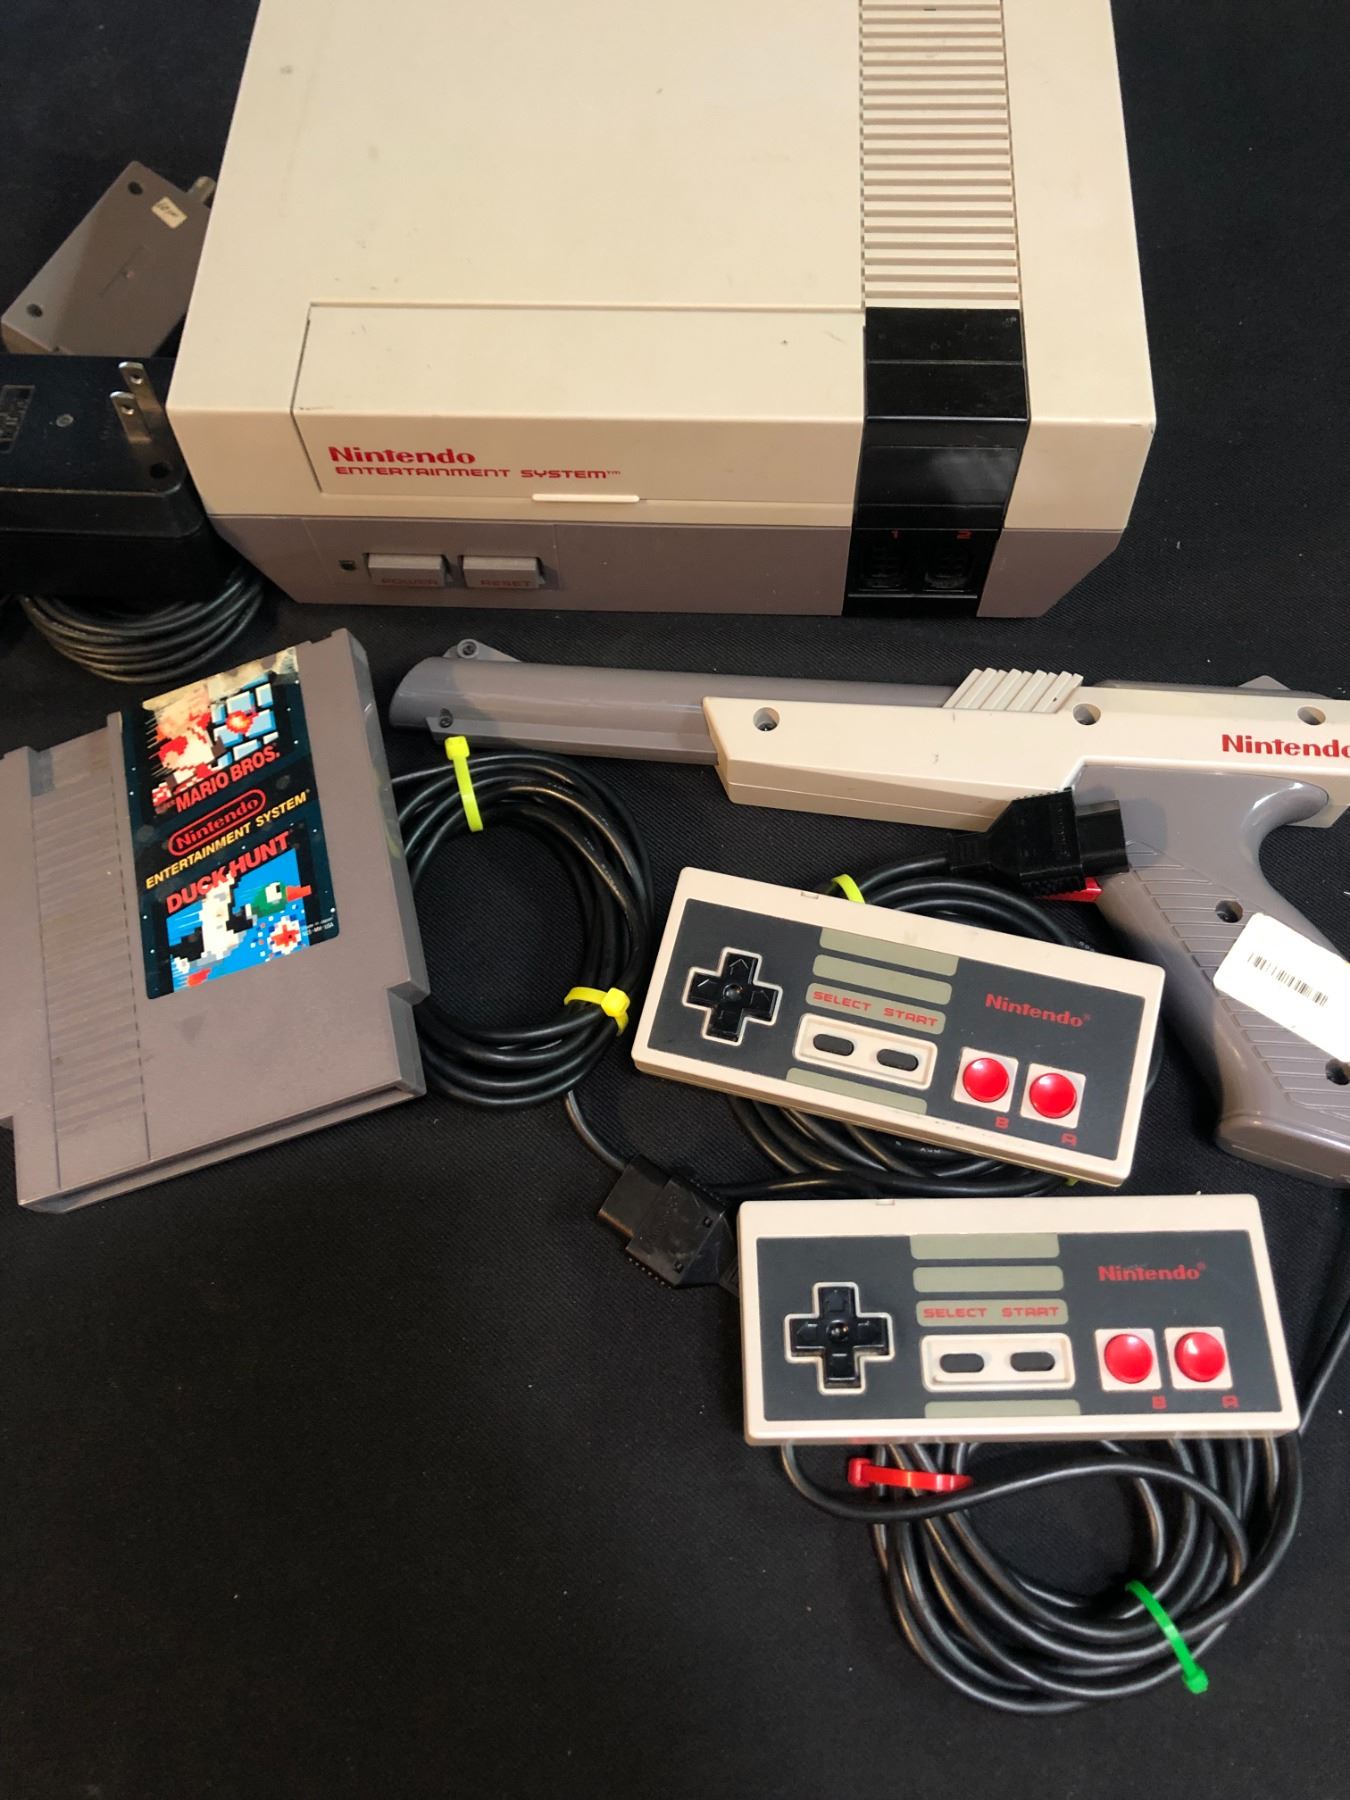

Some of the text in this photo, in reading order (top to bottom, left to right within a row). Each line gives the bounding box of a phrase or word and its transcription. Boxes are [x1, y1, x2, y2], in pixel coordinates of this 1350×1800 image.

[328, 446, 475, 464] Nintendo
[335, 466, 510, 477] ENTERTAINMENT
[480, 579, 531, 587] RESET
[175, 771, 229, 813] MARIO
[231, 747, 280, 782] BROS.
[176, 799, 259, 850] Nintendo
[146, 792, 307, 889] ENTERTAINMENT SYSTEM
[166, 831, 290, 913] DUCK HUNT
[813, 991, 938, 1027] SELECT START
[985, 993, 1084, 1028] Nintendo
[995, 1116, 1009, 1129] B
[1098, 1264, 1200, 1282] Nintendo
[923, 1306, 1059, 1319] SELECT START
[1152, 1396, 1167, 1409] B
